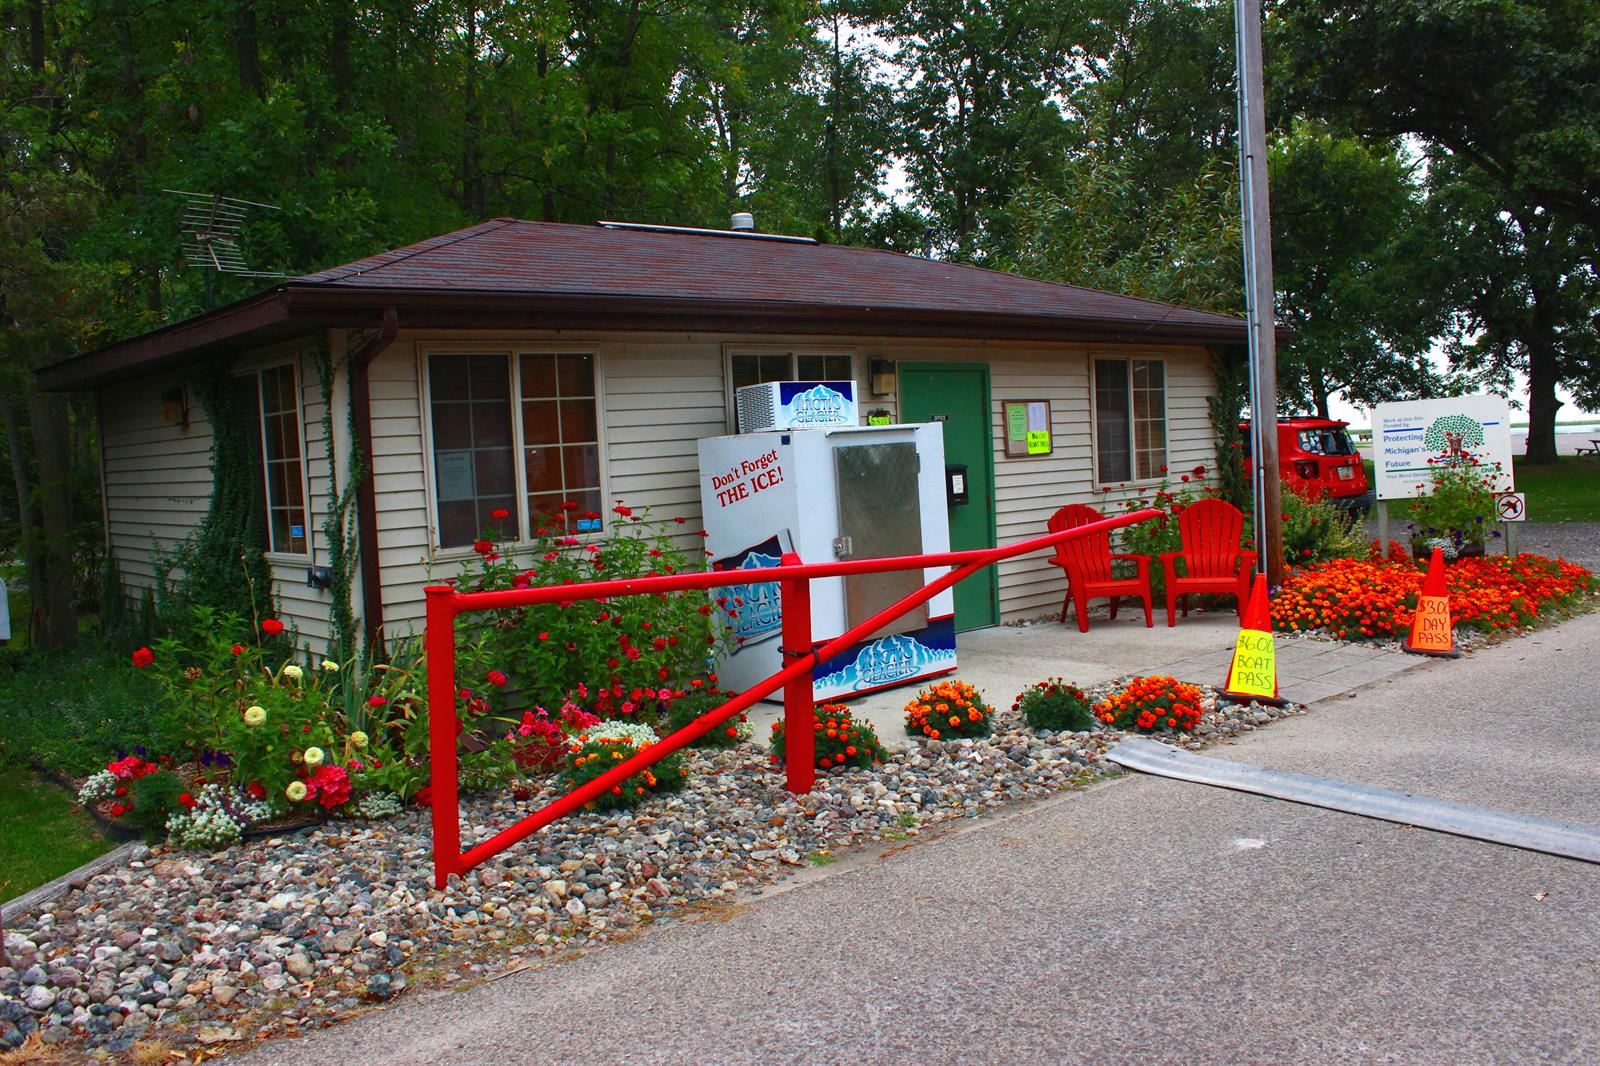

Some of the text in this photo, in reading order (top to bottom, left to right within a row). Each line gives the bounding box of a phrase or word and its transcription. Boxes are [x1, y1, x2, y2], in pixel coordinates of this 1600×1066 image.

[796, 394, 841, 411] ARCTIC
[797, 410, 841, 423] GLACIER
[1383, 434, 1424, 442] Protecting
[1384, 447, 1426, 455] Michigan's
[711, 448, 779, 491] Don't Forget
[1385, 460, 1411, 468] Future
[716, 465, 784, 508] THE ICE!
[1423, 617, 1447, 632] DAY
[1418, 631, 1449, 644] PASS
[860, 640, 914, 672] ARCTIC
[1237, 654, 1273, 671] BOAT
[863, 659, 914, 684] GLACIER
[1237, 671, 1273, 690] PASS
